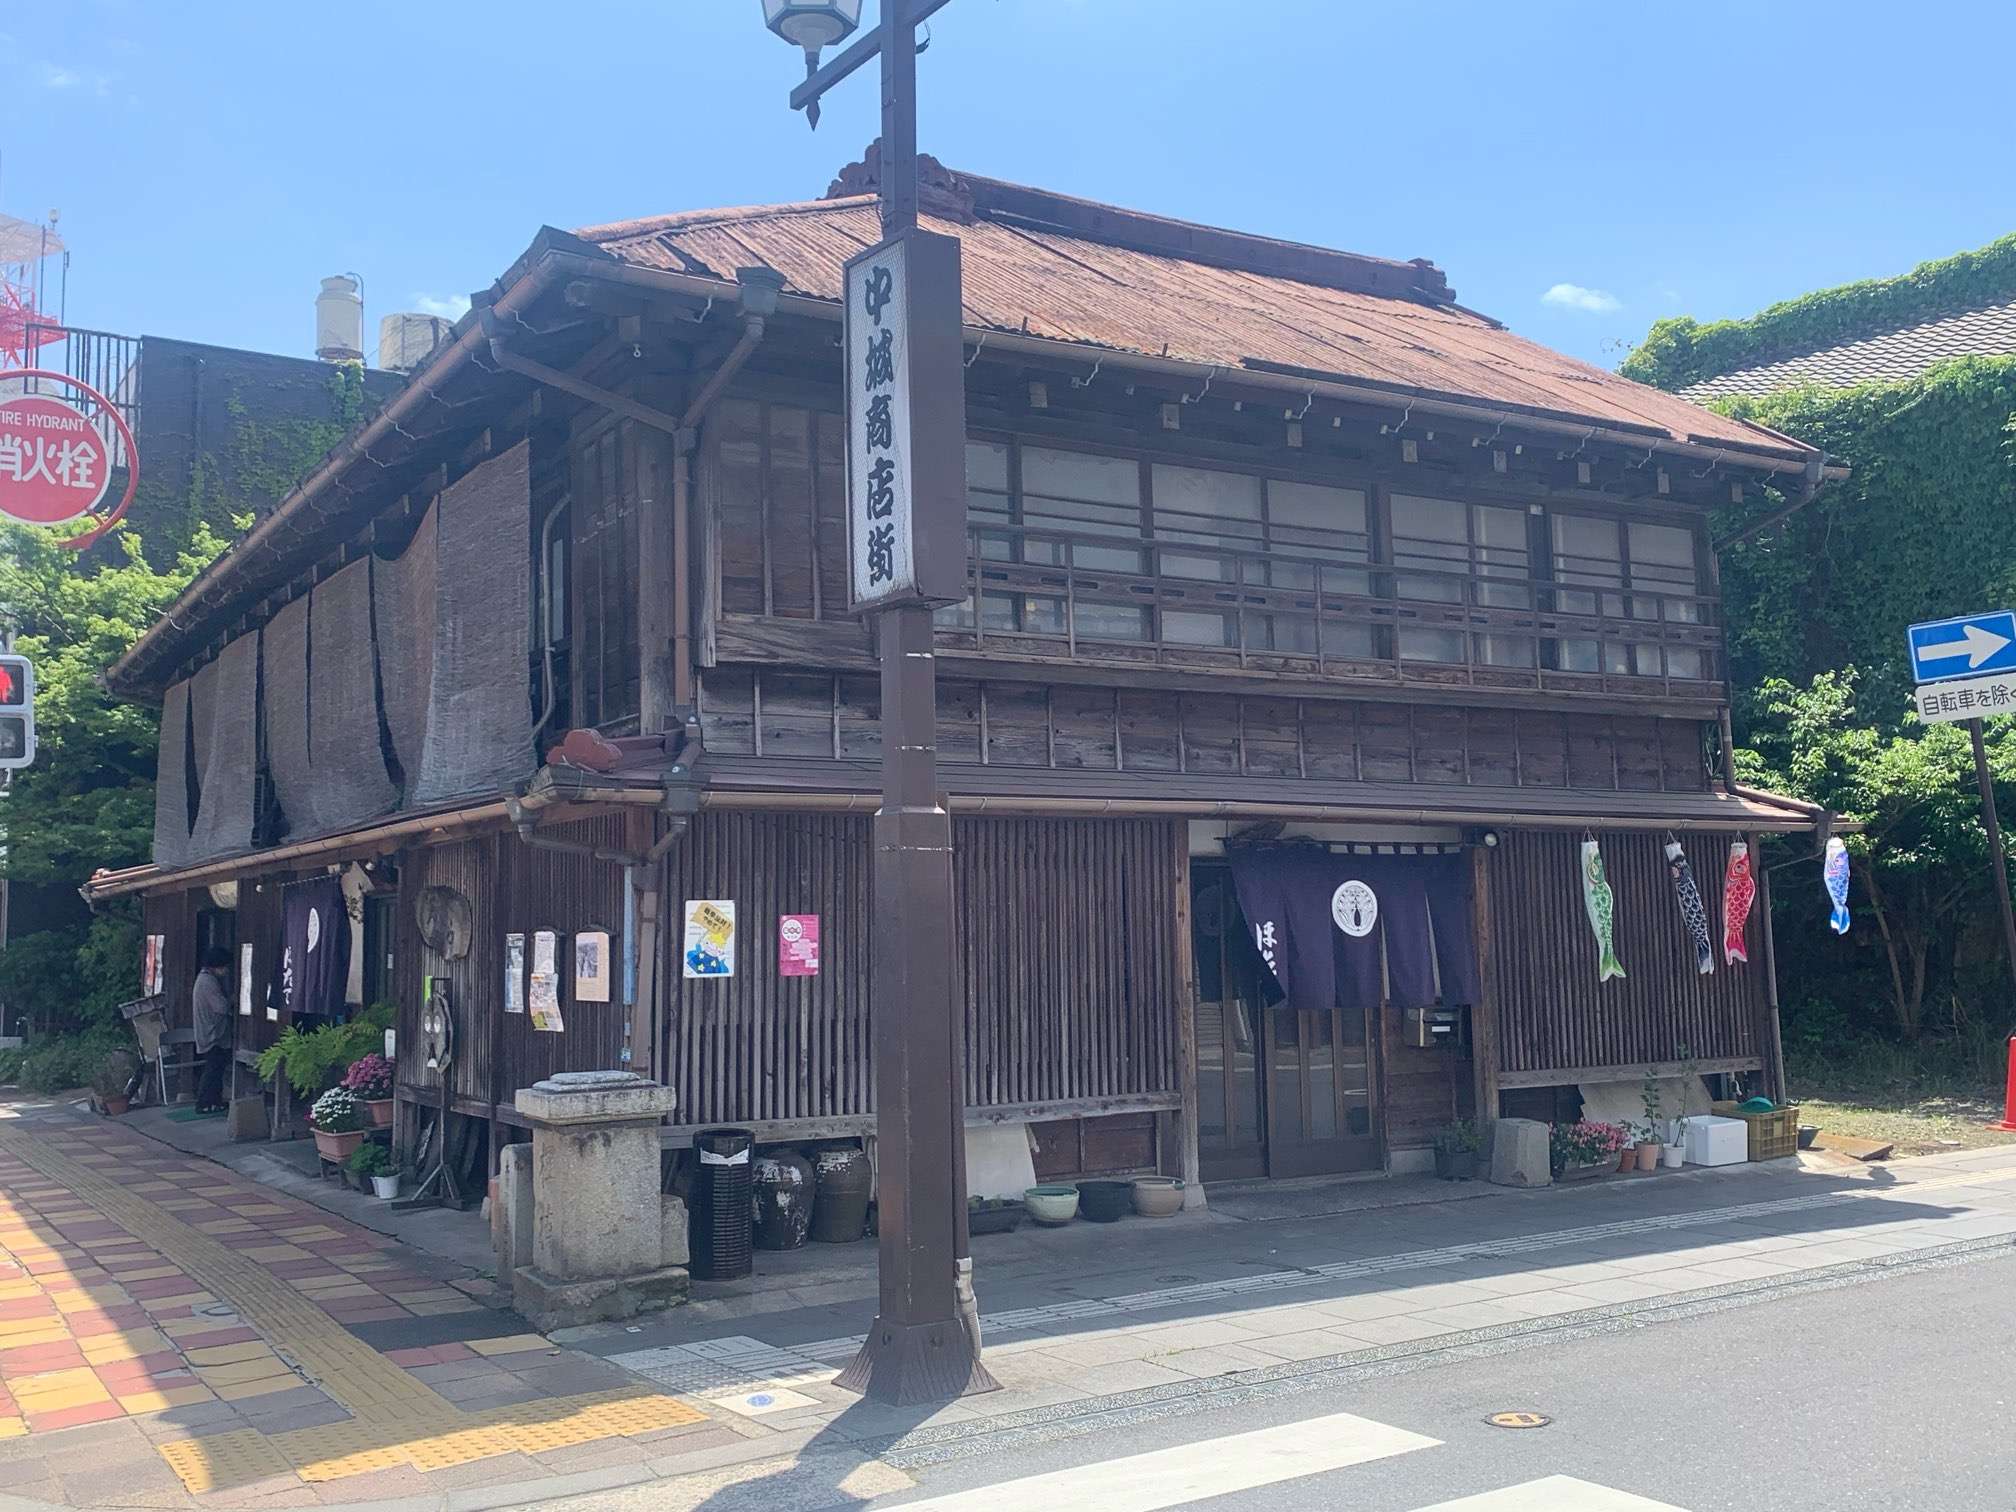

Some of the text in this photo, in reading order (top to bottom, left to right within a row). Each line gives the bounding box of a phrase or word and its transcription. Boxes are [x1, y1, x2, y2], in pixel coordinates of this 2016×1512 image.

[26, 413, 86, 432] HYDRANT
[865, 265, 895, 587] 中城商店街
